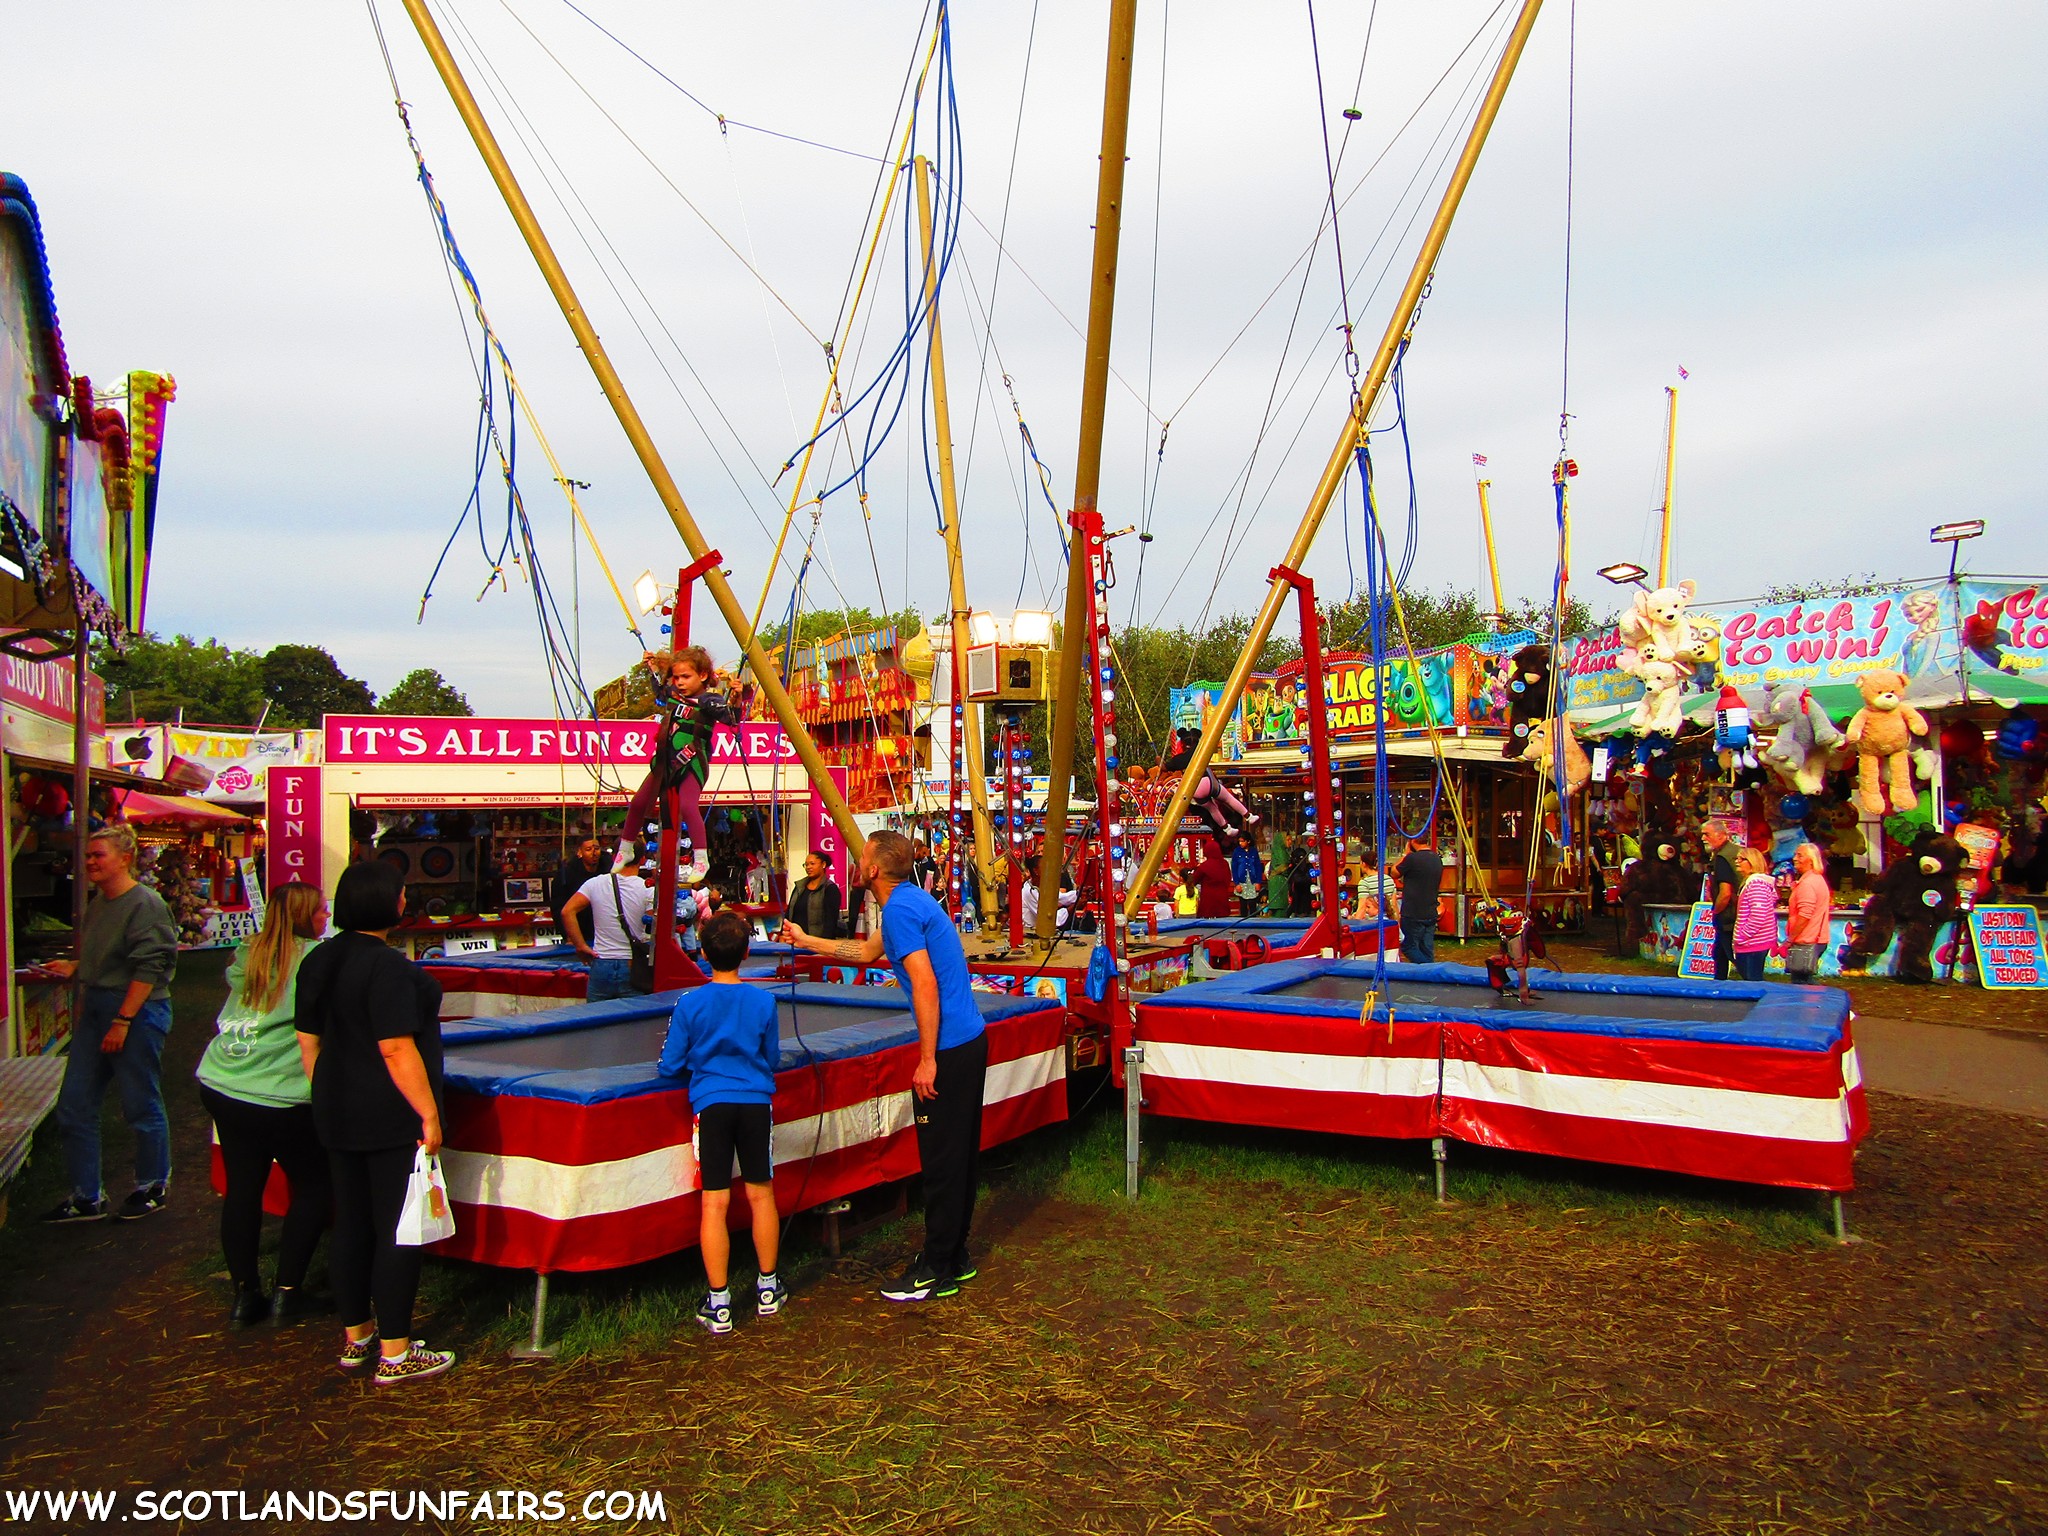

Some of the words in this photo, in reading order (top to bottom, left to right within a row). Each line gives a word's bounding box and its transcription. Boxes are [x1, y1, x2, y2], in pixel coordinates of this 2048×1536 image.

[1724, 601, 1855, 641] Catch
[1869, 599, 1892, 629] 1
[1726, 640, 1773, 666] to
[1786, 626, 1889, 663] win!
[1763, 665, 1820, 681] Every
[1827, 652, 1898, 678] Game!
[1322, 664, 1392, 704] LACE
[1328, 702, 1391, 729] RABS
[1718, 709, 1729, 737] ENERGY
[170, 733, 254, 758] WIN
[339, 727, 427, 755] IT'S
[436, 729, 522, 757] ALL
[530, 730, 611, 758] FUN
[620, 731, 648, 757] &
[284, 776, 304, 837] FUN
[1700, 909, 1713, 924] LAS
[1982, 911, 2006, 927] LAST
[2006, 911, 2027, 927] DAY
[461, 940, 488, 951] WIN
[1980, 929, 1994, 946] OF
[1994, 930, 2014, 946] THE
[2014, 930, 2038, 946] FAIR
[1689, 958, 1716, 974] REDUCE
[1990, 948, 2008, 964] ALL
[2008, 948, 2035, 965] TOYS
[1994, 967, 2038, 984] REDUCED
